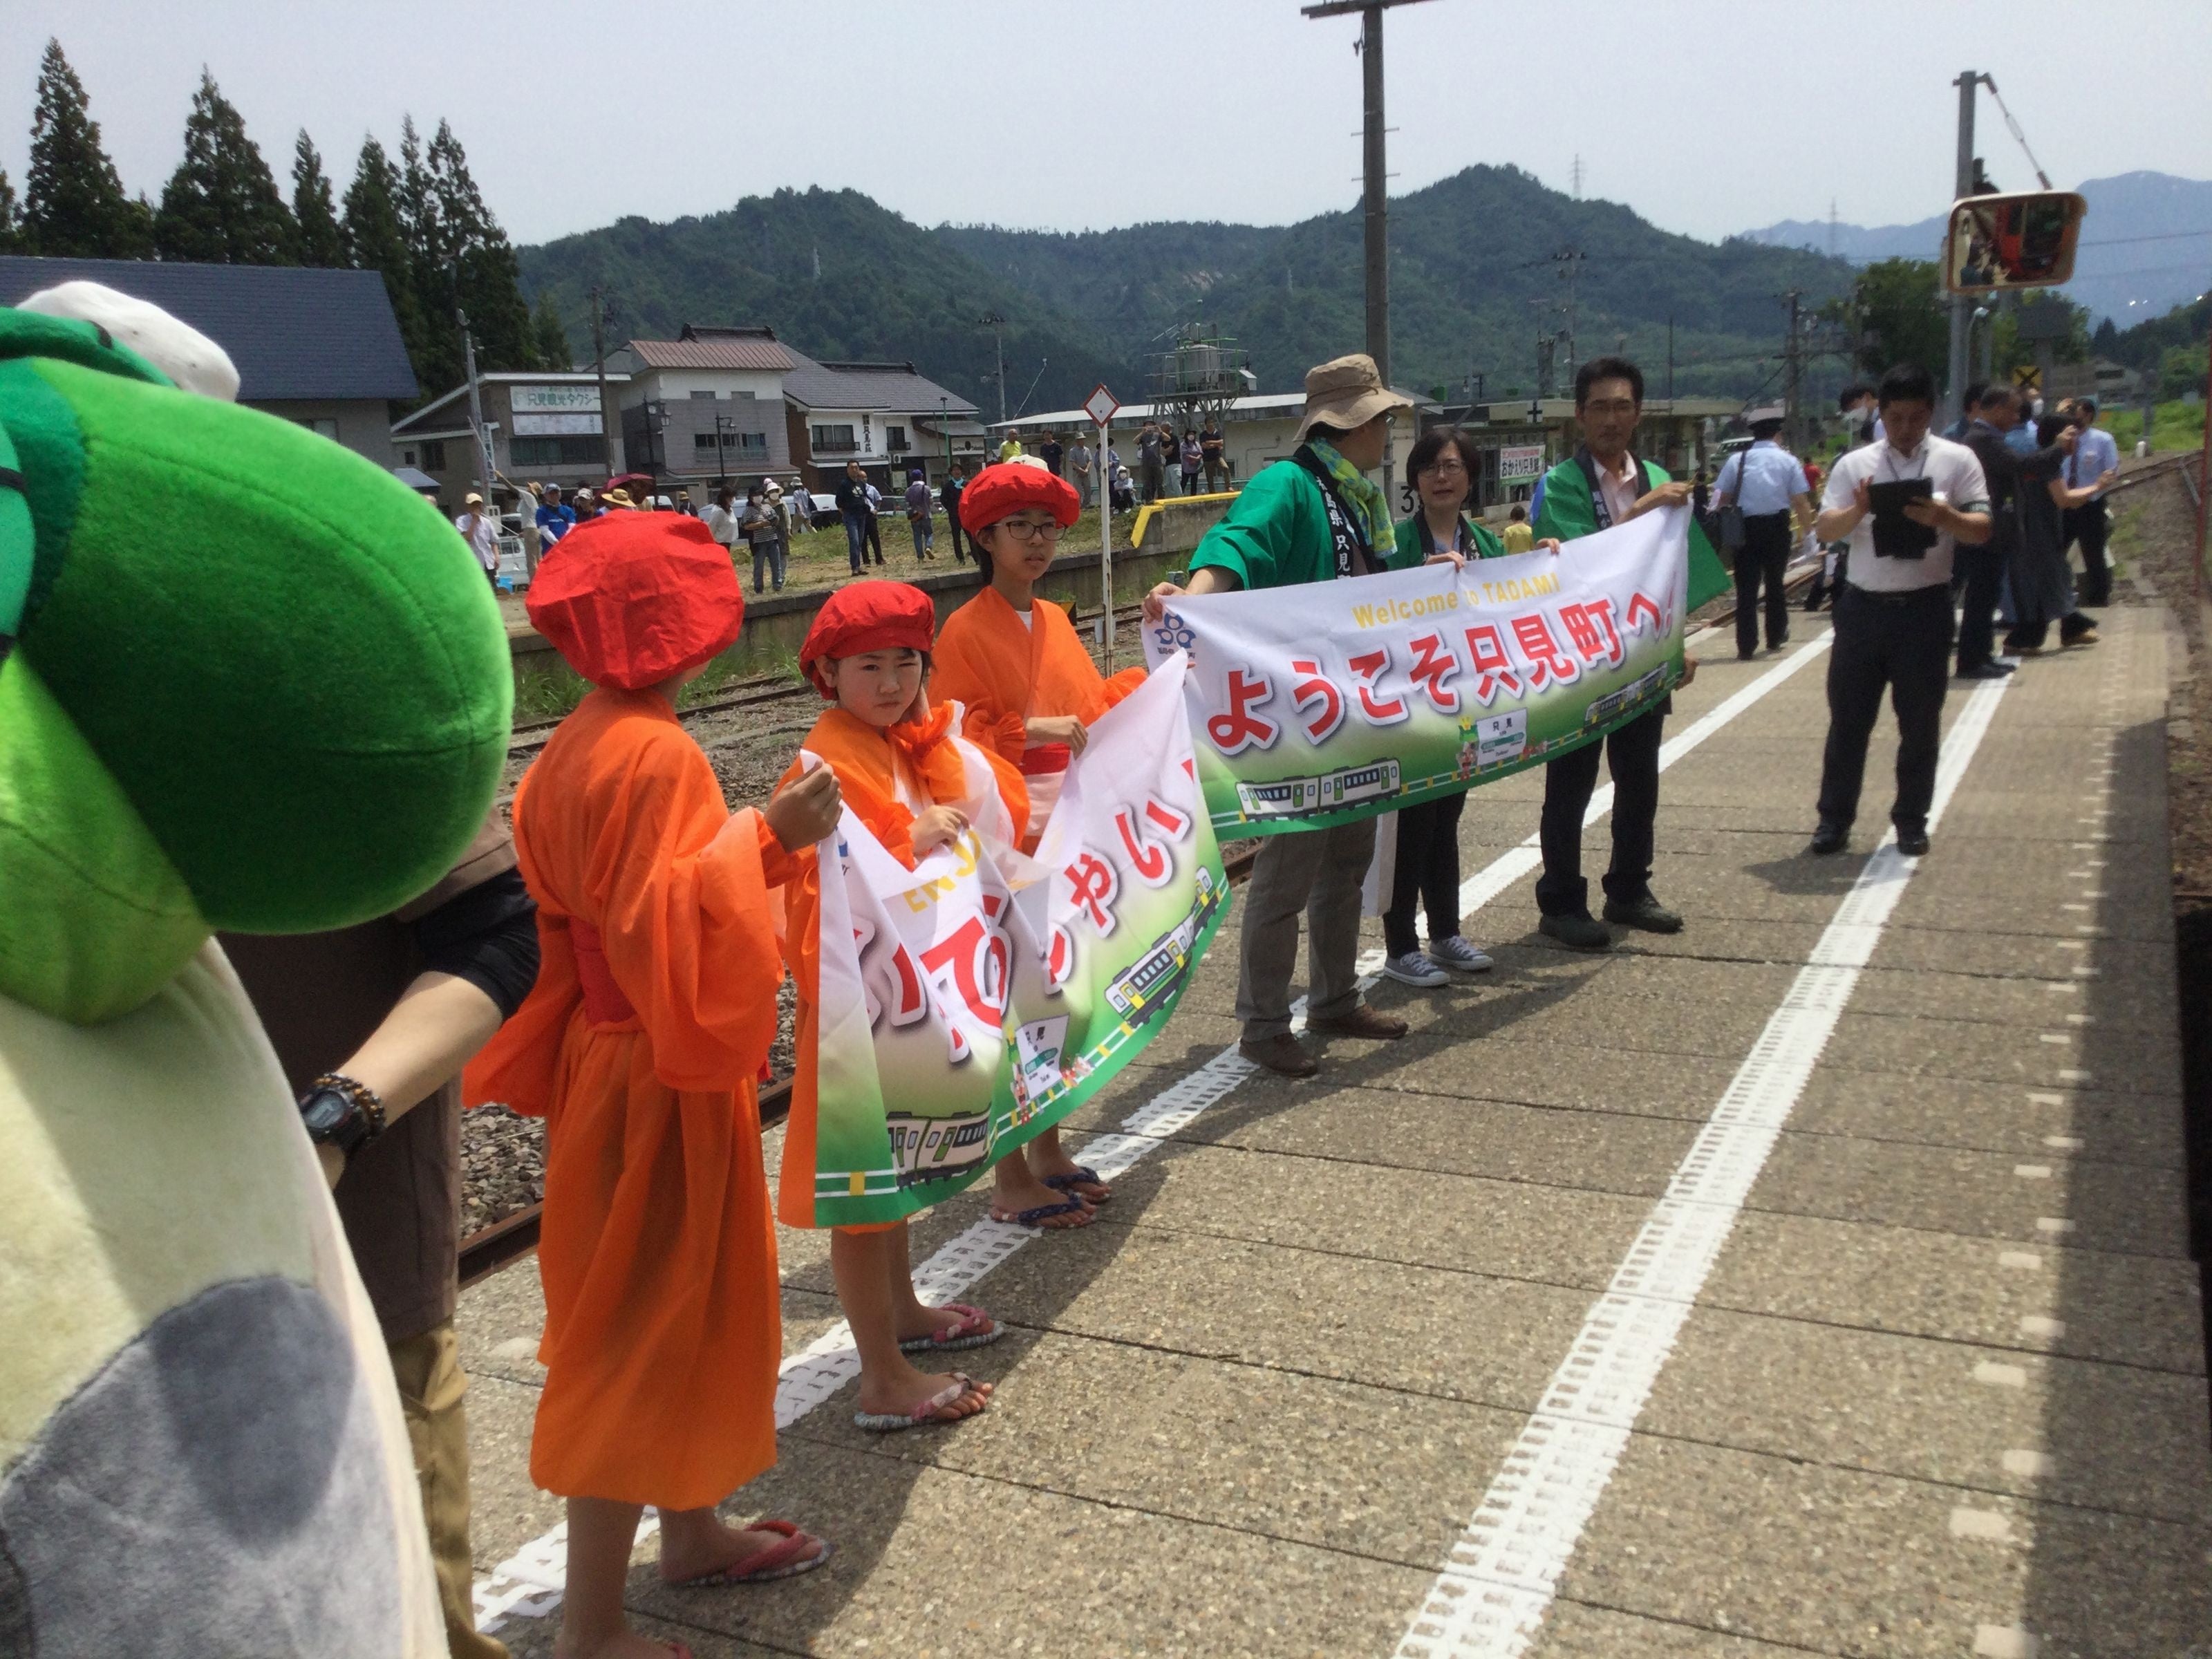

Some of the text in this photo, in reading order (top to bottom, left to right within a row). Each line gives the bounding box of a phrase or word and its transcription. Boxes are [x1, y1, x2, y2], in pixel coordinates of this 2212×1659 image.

[1351, 572, 1561, 629] Welcome to TADAMI
